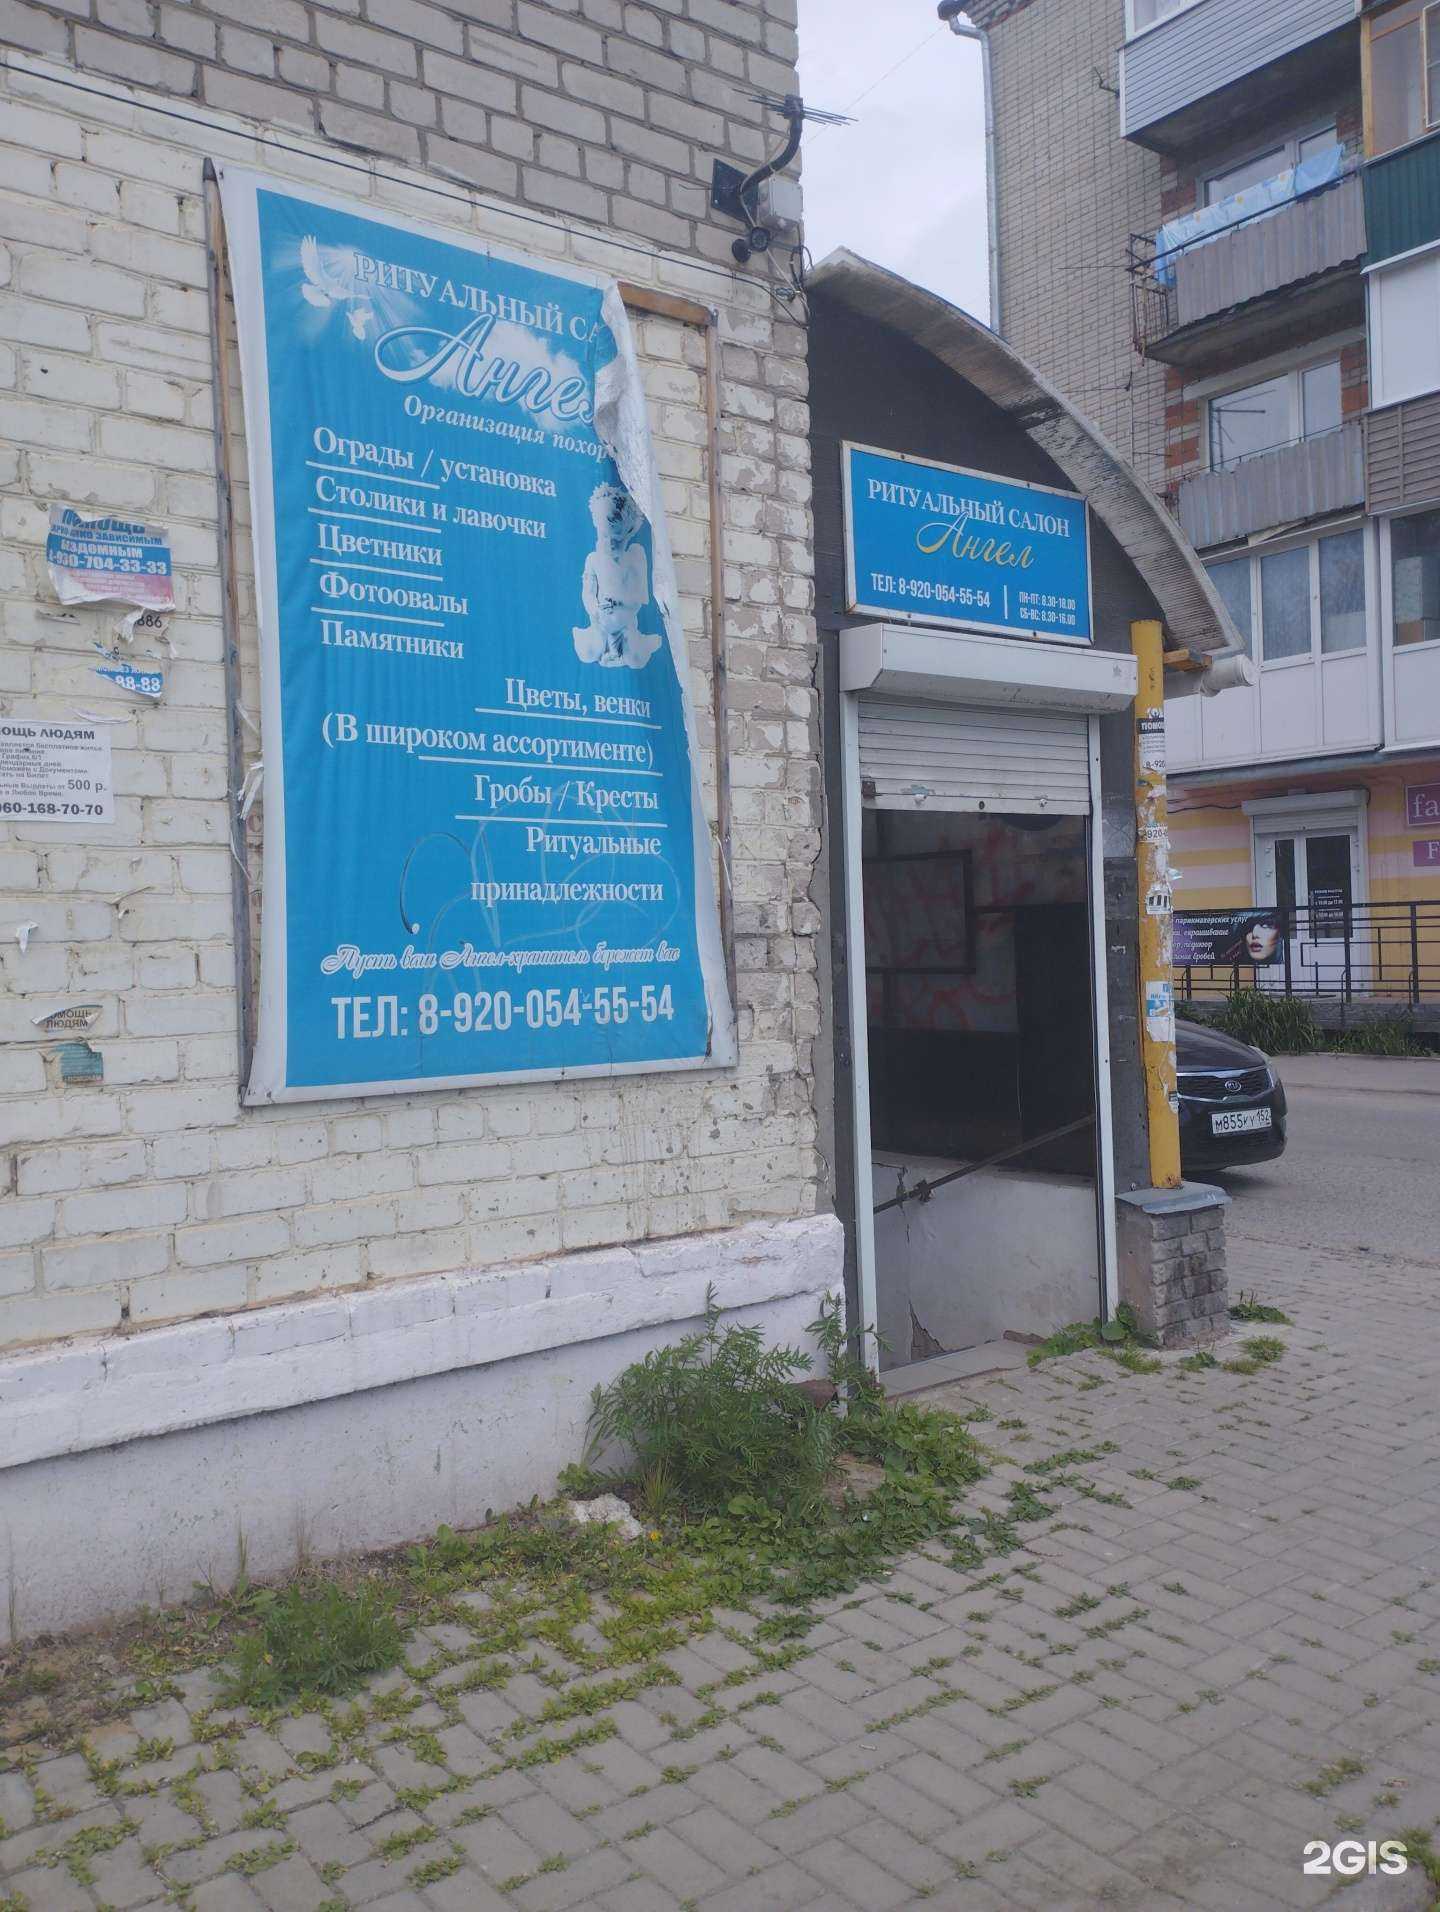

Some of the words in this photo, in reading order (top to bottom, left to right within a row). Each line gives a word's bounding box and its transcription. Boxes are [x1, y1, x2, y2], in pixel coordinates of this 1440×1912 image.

[353, 251, 563, 334] РИТУАЛЬНЫЙ
[404, 394, 546, 444] Организация
[552, 431, 608, 463] похор
[313, 425, 414, 470] Ограды
[420, 449, 434, 477] /
[439, 456, 557, 497] установка
[315, 474, 426, 518] Столики
[432, 501, 448, 522] и
[452, 507, 547, 539] лавочки
[867, 478, 1006, 525] РИТУАЛЬНЫЙ
[1008, 508, 1071, 538] САЛОН
[317, 522, 443, 566] Цветники
[916, 511, 1035, 569] Ангел
[319, 571, 469, 616] Фотоовалы
[871, 572, 897, 594] ТЕЛ:
[898, 578, 991, 609] 8-920-054-55-54
[320, 619, 464, 661] Памятники
[505, 677, 587, 714] Цветы,
[593, 691, 651, 718] венки
[322, 711, 358, 748] (В
[365, 722, 487, 754] широком
[493, 729, 654, 770] ассортименте)
[67, 779, 91, 791] 500
[473, 774, 552, 806] Гробы
[557, 780, 570, 812] /
[576, 780, 659, 814] Кресты
[0, 801, 104, 816] 60-168-70-70
[525, 826, 662, 860] Ритуальные
[471, 878, 664, 907] принадлежности
[321, 943, 398, 979] Пусть
[331, 994, 408, 1040] ТЕЛ:
[418, 983, 675, 1036] 8-920-054-55-54
